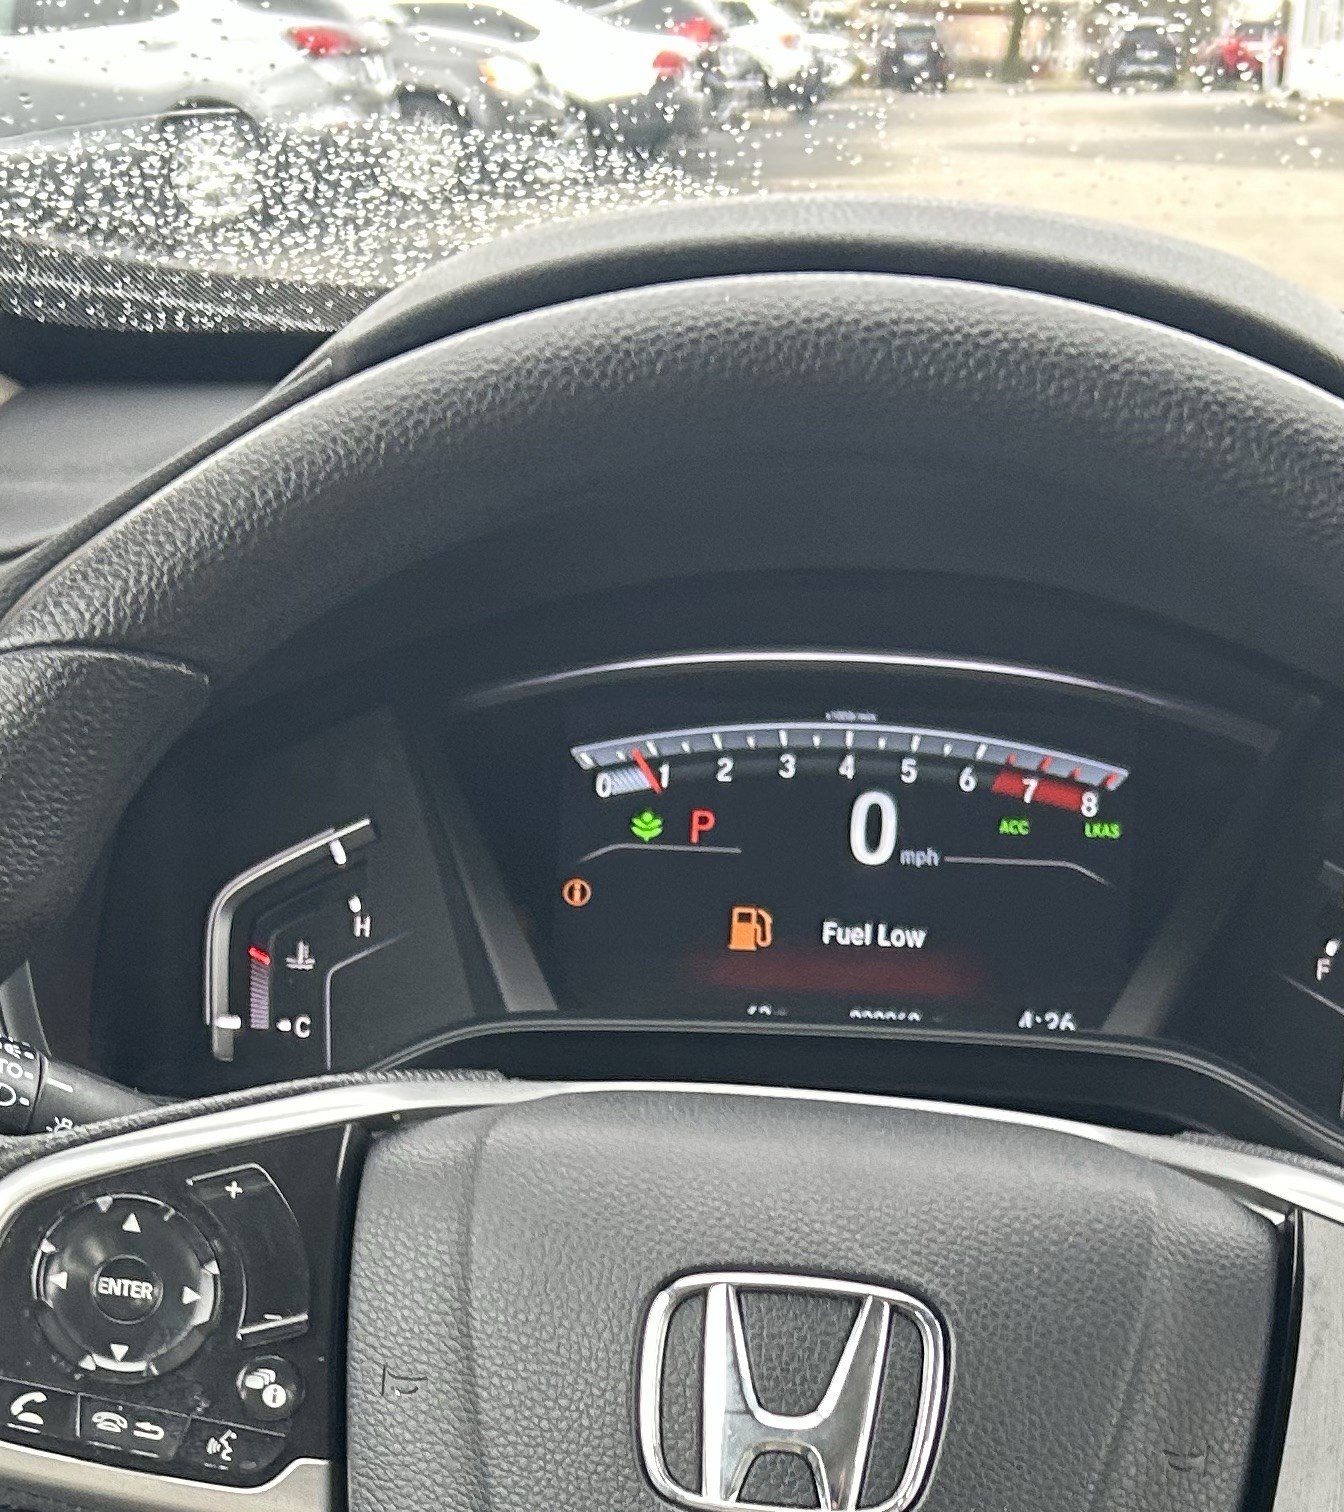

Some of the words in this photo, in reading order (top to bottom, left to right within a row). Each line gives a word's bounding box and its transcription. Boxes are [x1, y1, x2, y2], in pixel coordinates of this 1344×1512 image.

[595, 771, 613, 799] 0
[659, 763, 670, 789] 1
[716, 757, 734, 782] 2
[778, 753, 796, 779] 3
[838, 754, 855, 780] 4
[900, 758, 917, 784] 5
[959, 766, 977, 792] 6
[1022, 776, 1039, 804] 7
[1081, 791, 1099, 818] 8
[689, 807, 717, 845] P
[850, 790, 897, 866] 0
[899, 848, 940, 869] mph
[998, 818, 1030, 836] ACC
[1084, 821, 1122, 840] LKAS
[822, 922, 873, 947] Fuel
[877, 924, 927, 950] Low
[1316, 958, 1331, 981] F
[294, 1015, 311, 1039] C
[97, 1277, 154, 1301] ENTER
